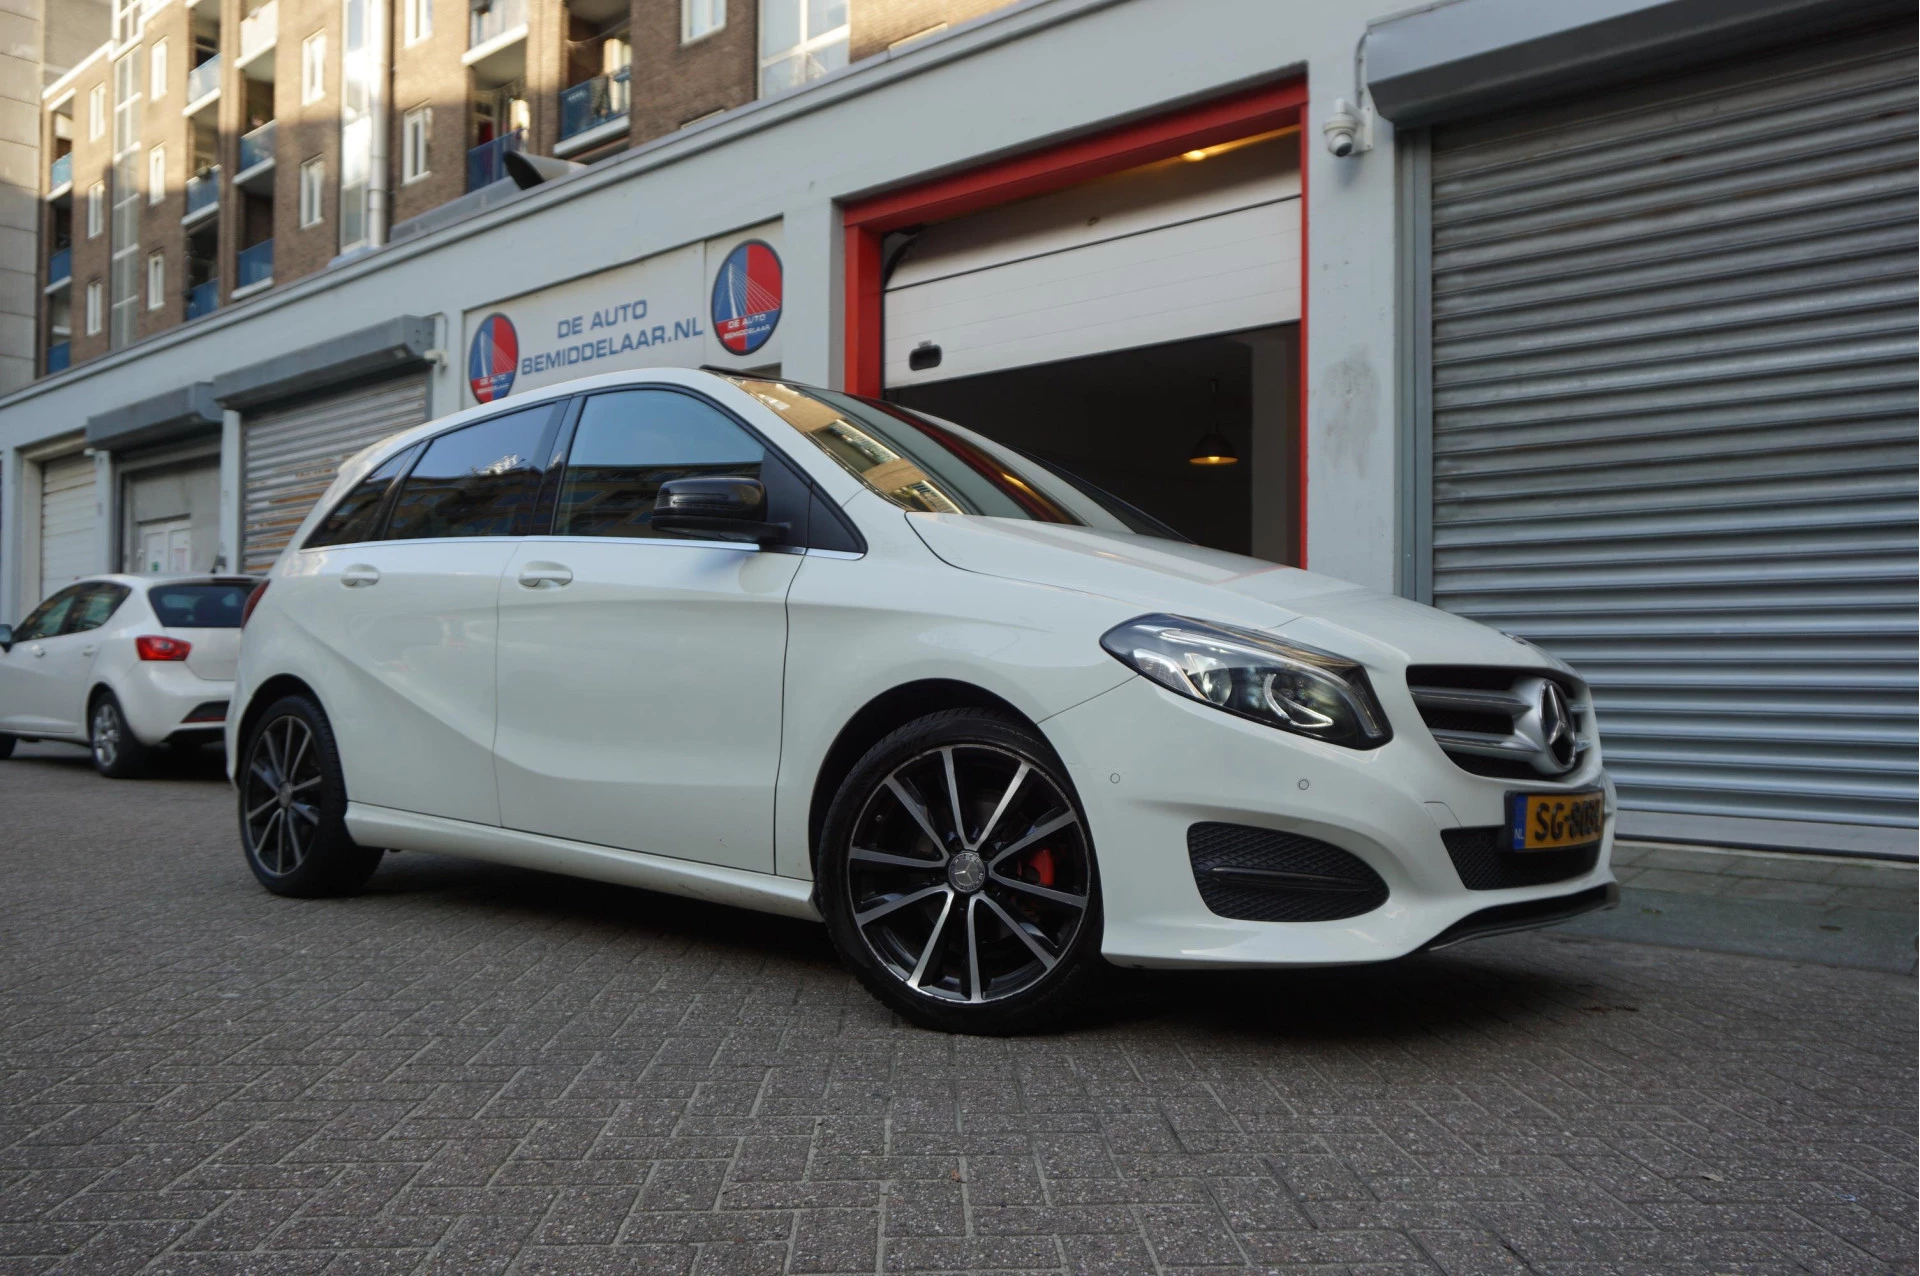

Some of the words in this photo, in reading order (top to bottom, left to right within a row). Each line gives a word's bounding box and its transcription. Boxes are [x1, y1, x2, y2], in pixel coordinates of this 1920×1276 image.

[558, 316, 583, 338] DE
[590, 299, 647, 330] AUTO
[728, 319, 740, 329] DE
[742, 313, 766, 326] AUTO
[521, 317, 703, 376] BEMIDDELAAR.NL
[1514, 828, 1524, 840] NL
